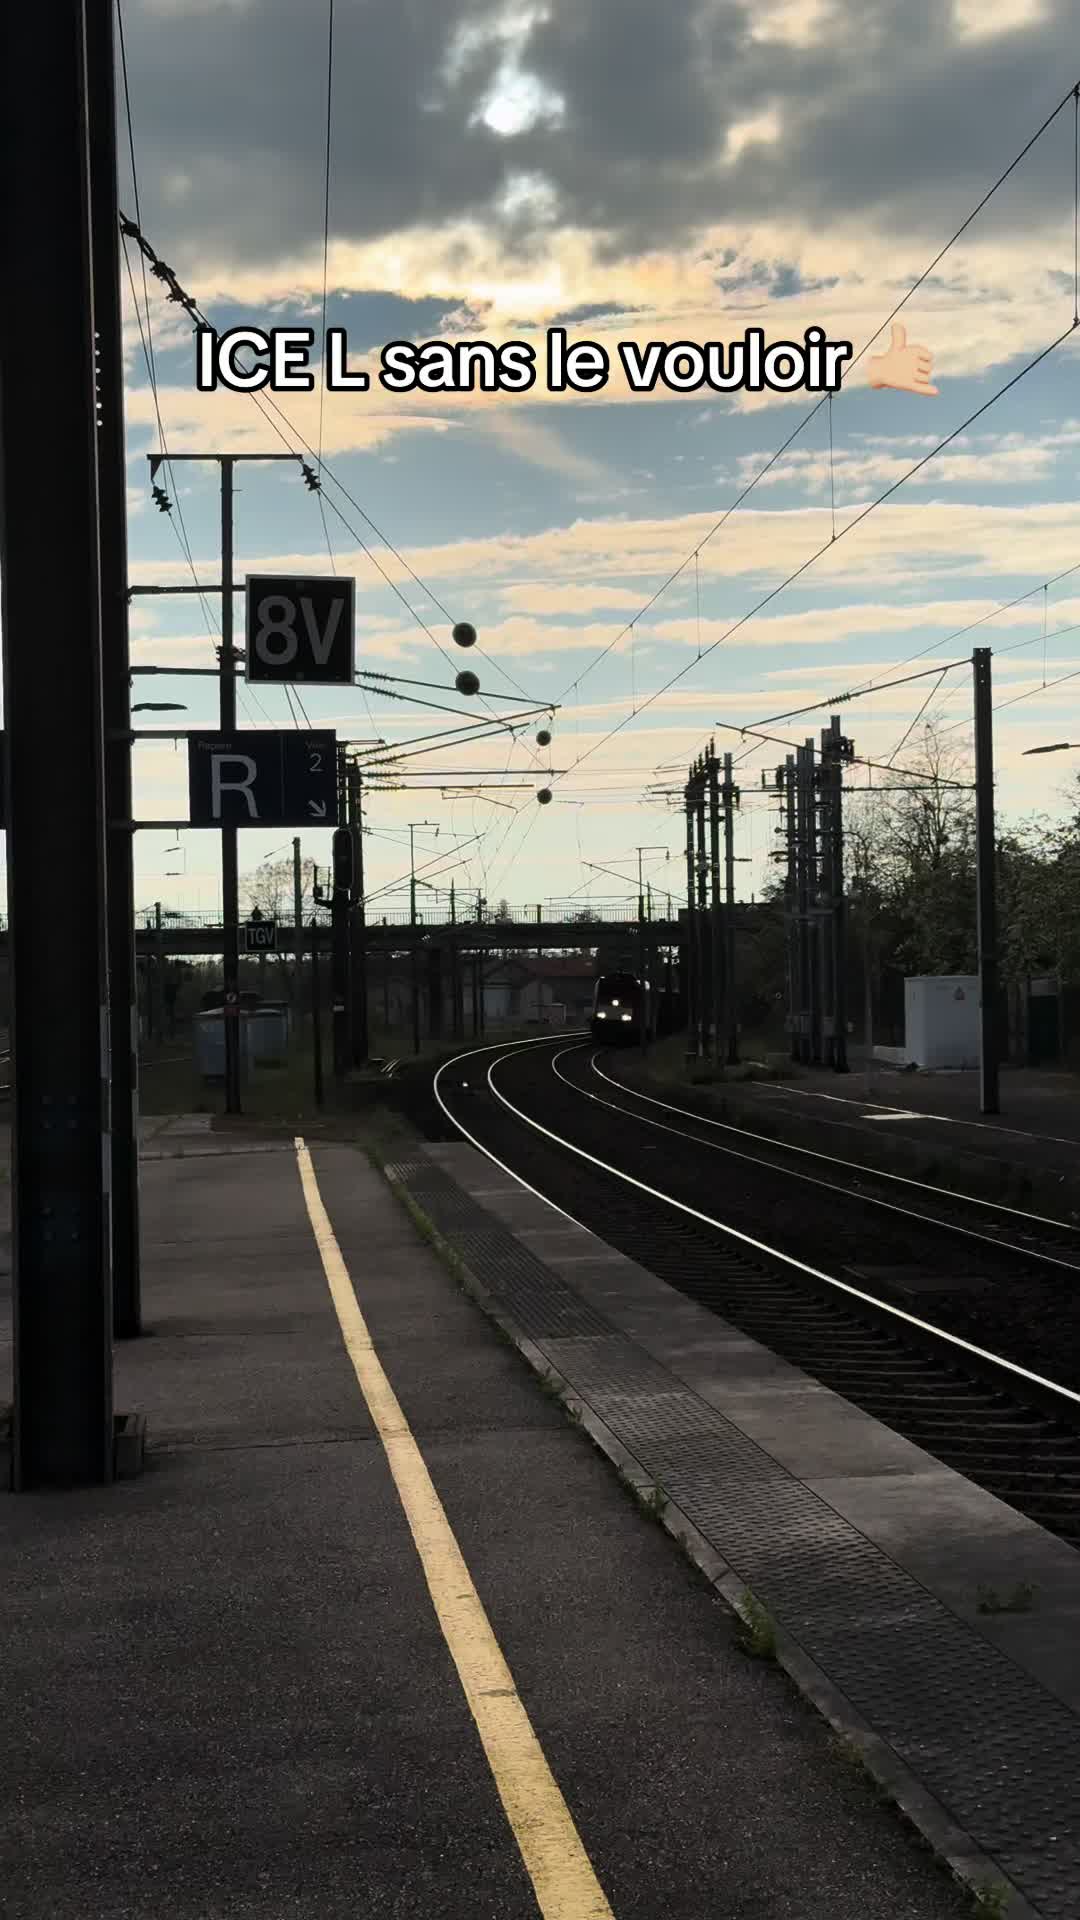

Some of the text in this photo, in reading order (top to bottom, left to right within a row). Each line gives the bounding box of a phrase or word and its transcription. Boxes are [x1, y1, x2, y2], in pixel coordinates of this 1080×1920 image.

[255, 595, 345, 665] 8V
[309, 752, 323, 772] 2
[210, 754, 260, 819] R
[247, 927, 274, 945] TGV
